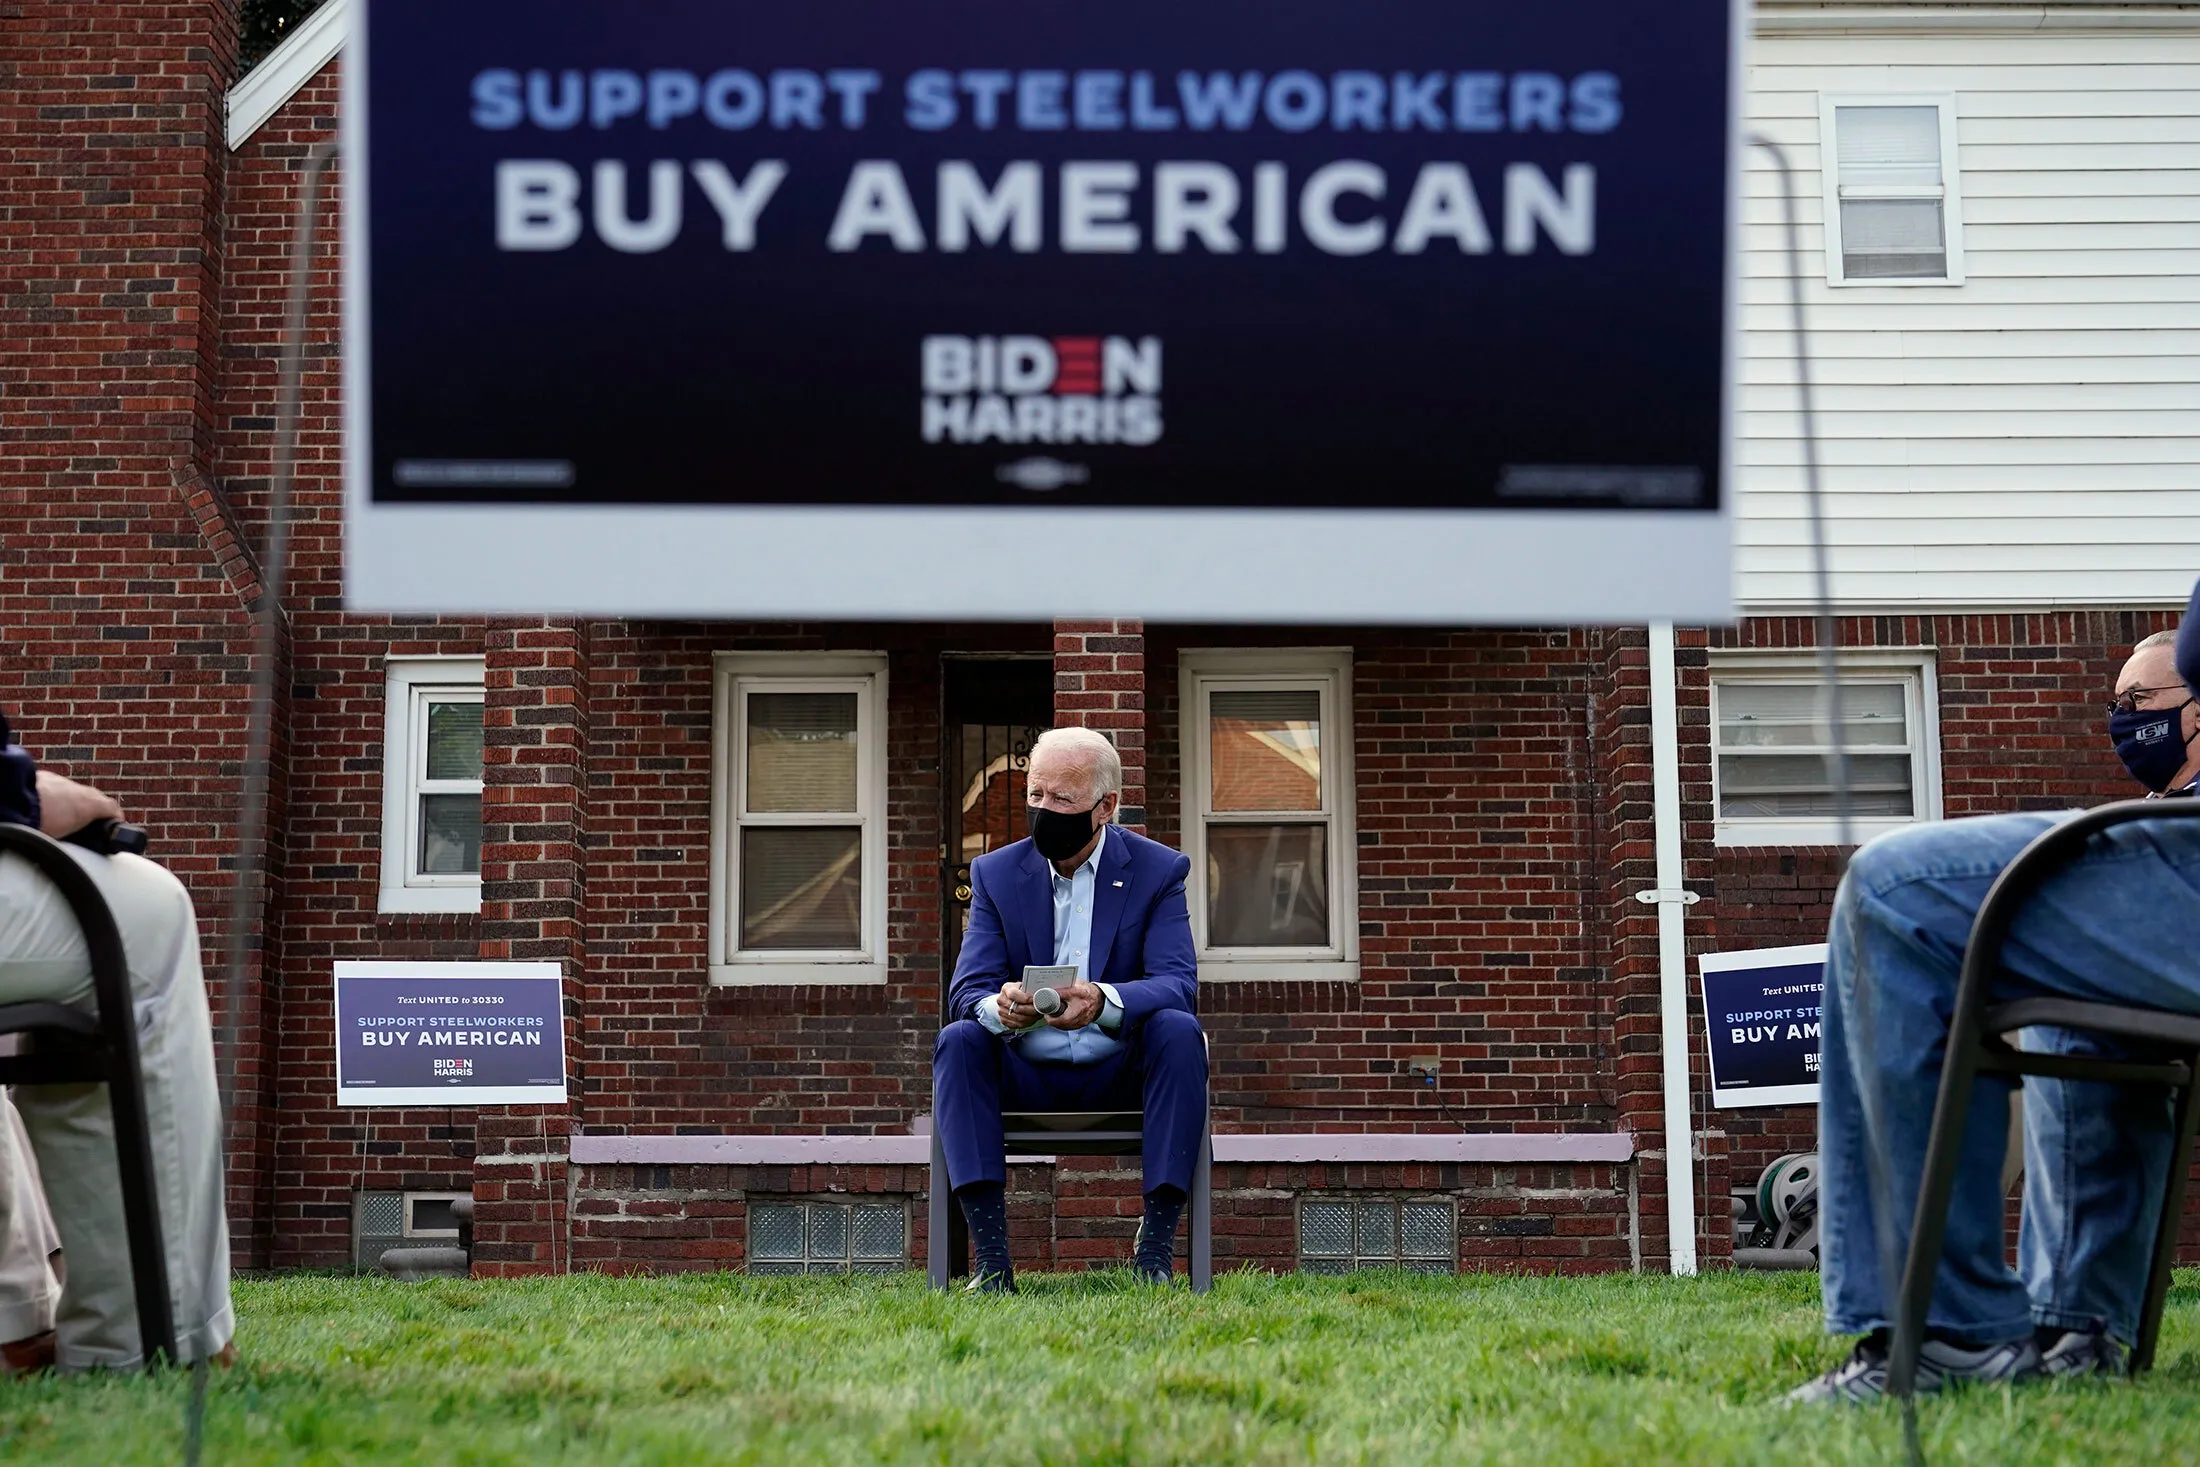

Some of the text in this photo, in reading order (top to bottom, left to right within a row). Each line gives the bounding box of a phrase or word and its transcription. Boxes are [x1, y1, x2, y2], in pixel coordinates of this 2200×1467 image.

[470, 68, 1622, 132] SUPPORT STEELWORKERS
[494, 158, 1597, 256] BUY AMERICAN
[921, 334, 1163, 394] BIDEN
[921, 394, 1164, 446] HARRIS
[2136, 723, 2169, 740] USW
[1763, 984, 1825, 996] Text UNITED
[397, 996, 504, 1004] Text UNITED to 30330
[358, 1017, 544, 1027] SUPPORT STEELWORKERS
[1726, 1009, 1792, 1023] SUPPORT
[362, 1031, 541, 1046] BUY AMERICAN
[1732, 1023, 1822, 1043] BUY AM
[433, 1059, 473, 1068] BIDEN
[434, 1068, 473, 1076] HARRIS
